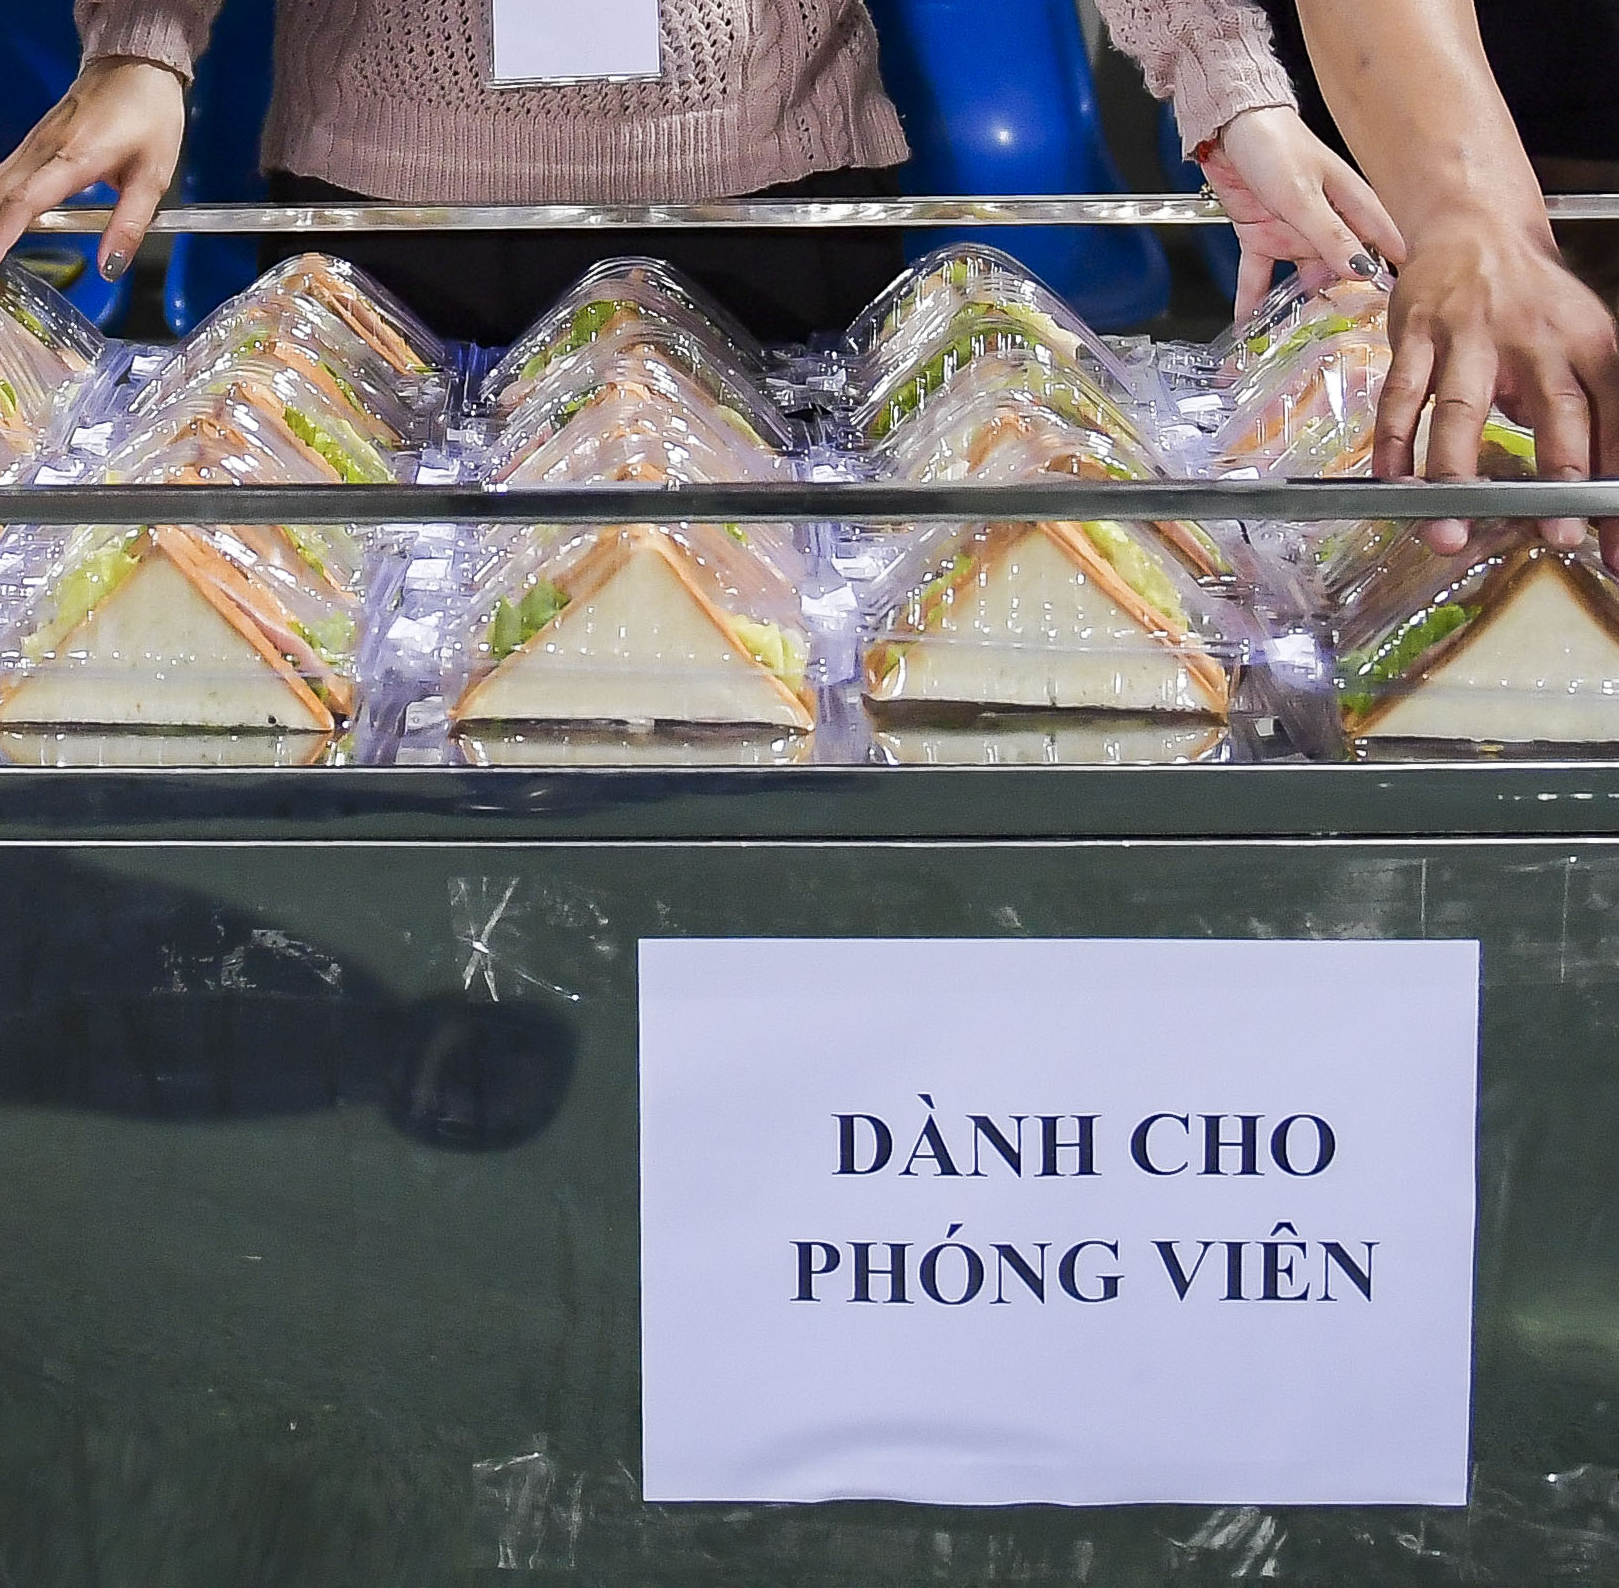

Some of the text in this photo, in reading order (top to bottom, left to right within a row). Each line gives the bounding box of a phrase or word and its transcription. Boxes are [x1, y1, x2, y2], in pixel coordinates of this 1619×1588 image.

[830, 1092, 1337, 1179] DÀNH CHO
[788, 1220, 1381, 1306] PHÓNG VIÊN
